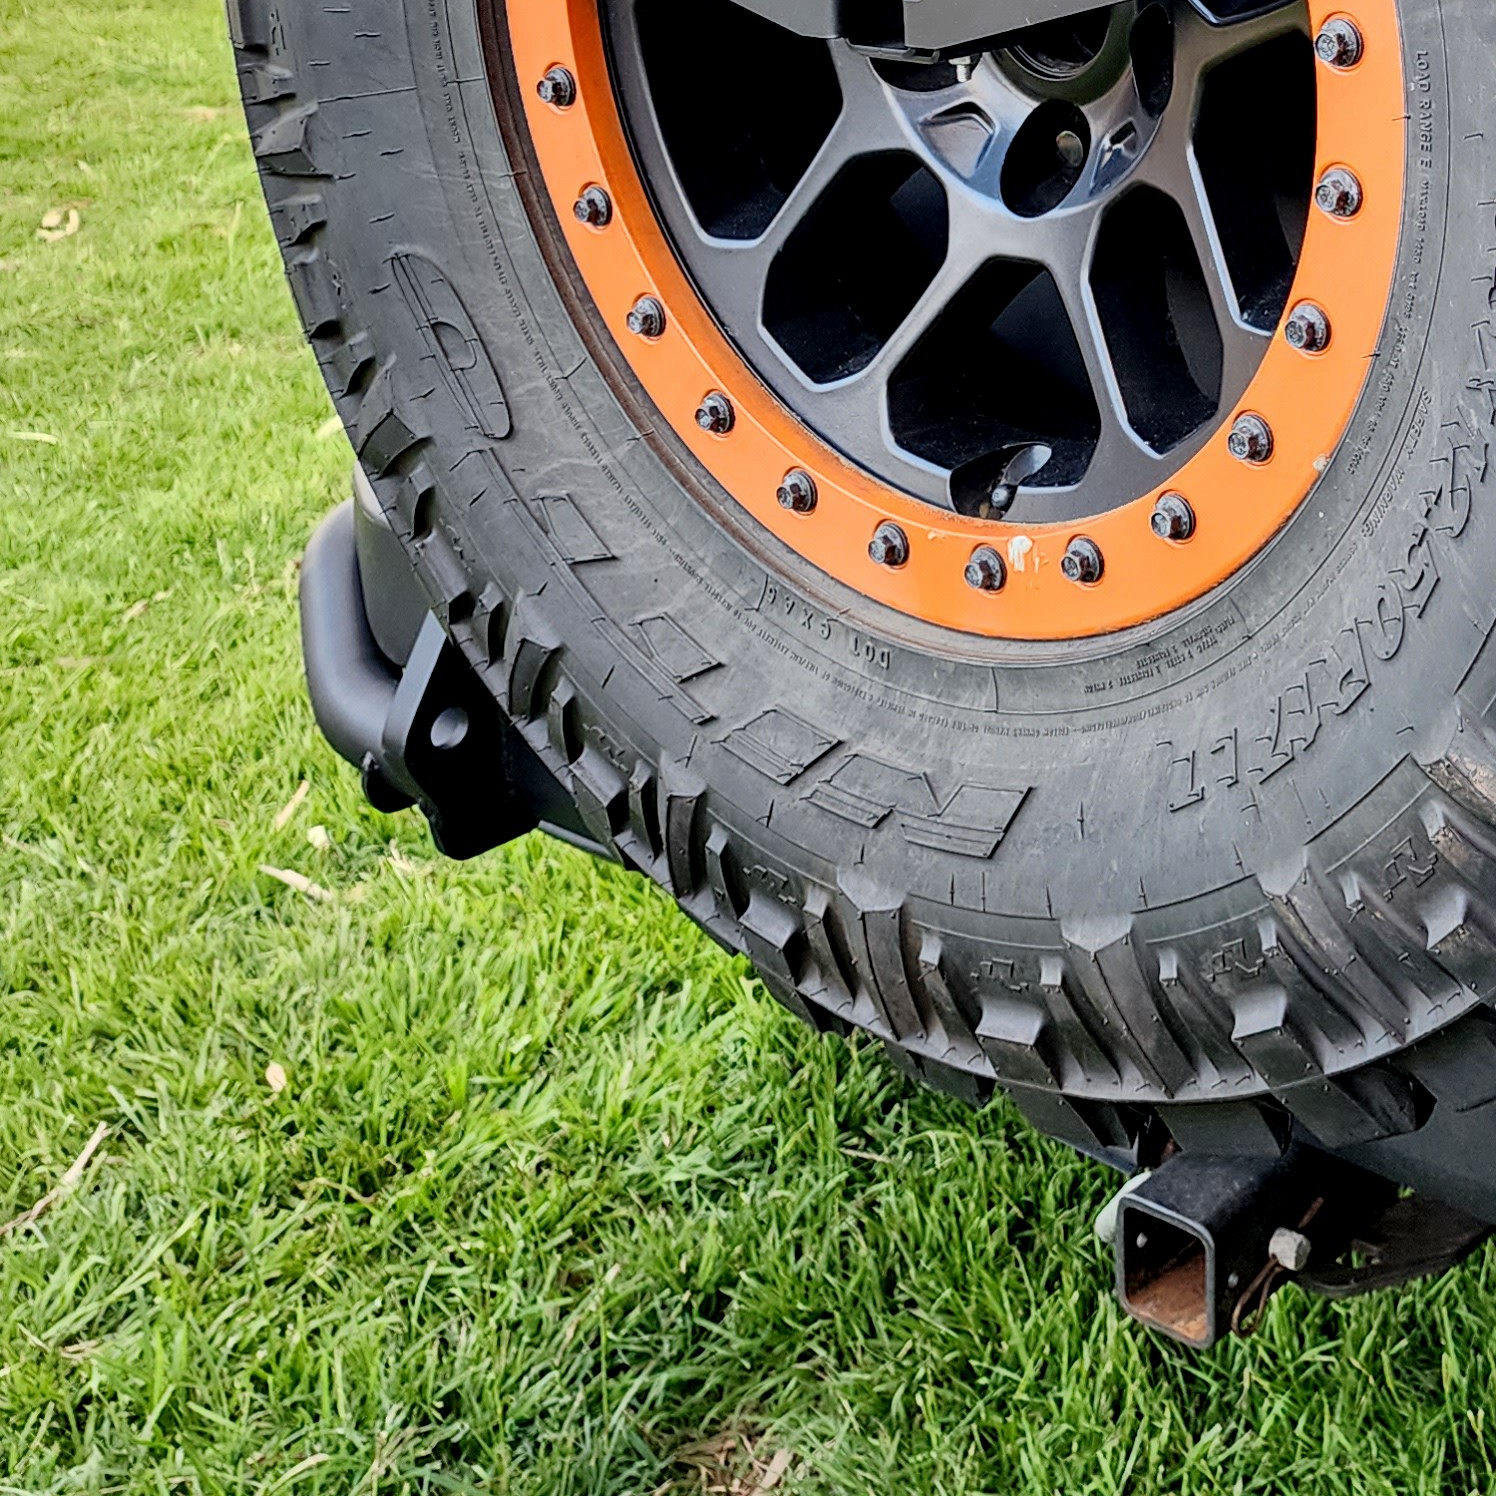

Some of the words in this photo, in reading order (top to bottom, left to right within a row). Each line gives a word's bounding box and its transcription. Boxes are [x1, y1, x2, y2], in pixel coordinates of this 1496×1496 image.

[1415, 49, 1431, 93] LOAD
[1418, 99, 1433, 154] RANGE
[1419, 157, 1433, 170] E
[1403, 387, 1432, 460] SAFETY
[390, 251, 1035, 860] NITTO
